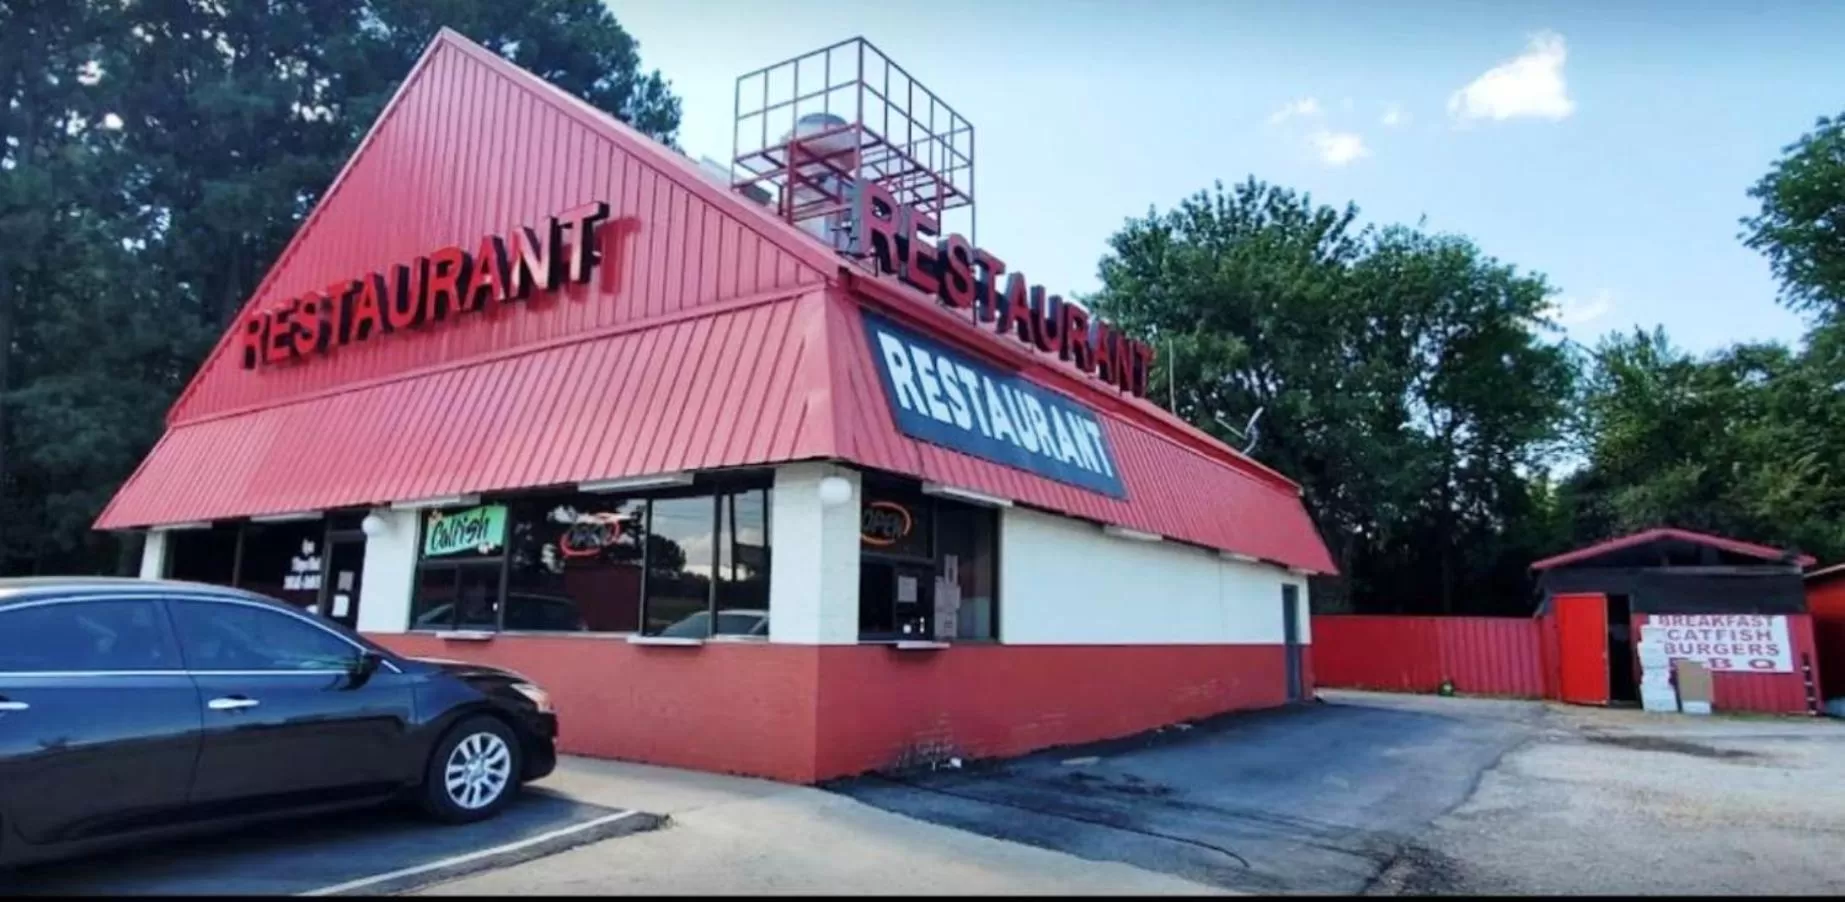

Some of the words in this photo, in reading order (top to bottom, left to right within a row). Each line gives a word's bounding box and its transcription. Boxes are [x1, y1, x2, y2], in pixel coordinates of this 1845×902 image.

[242, 200, 611, 371] RESTAURANT
[848, 178, 1155, 398] RESTAURANT
[877, 332, 1114, 478] RESTAURANT
[1658, 614, 1774, 627] BREAKFAST
[1664, 643, 1780, 656] BURGERS
[1667, 629, 1772, 642] CATFISH
